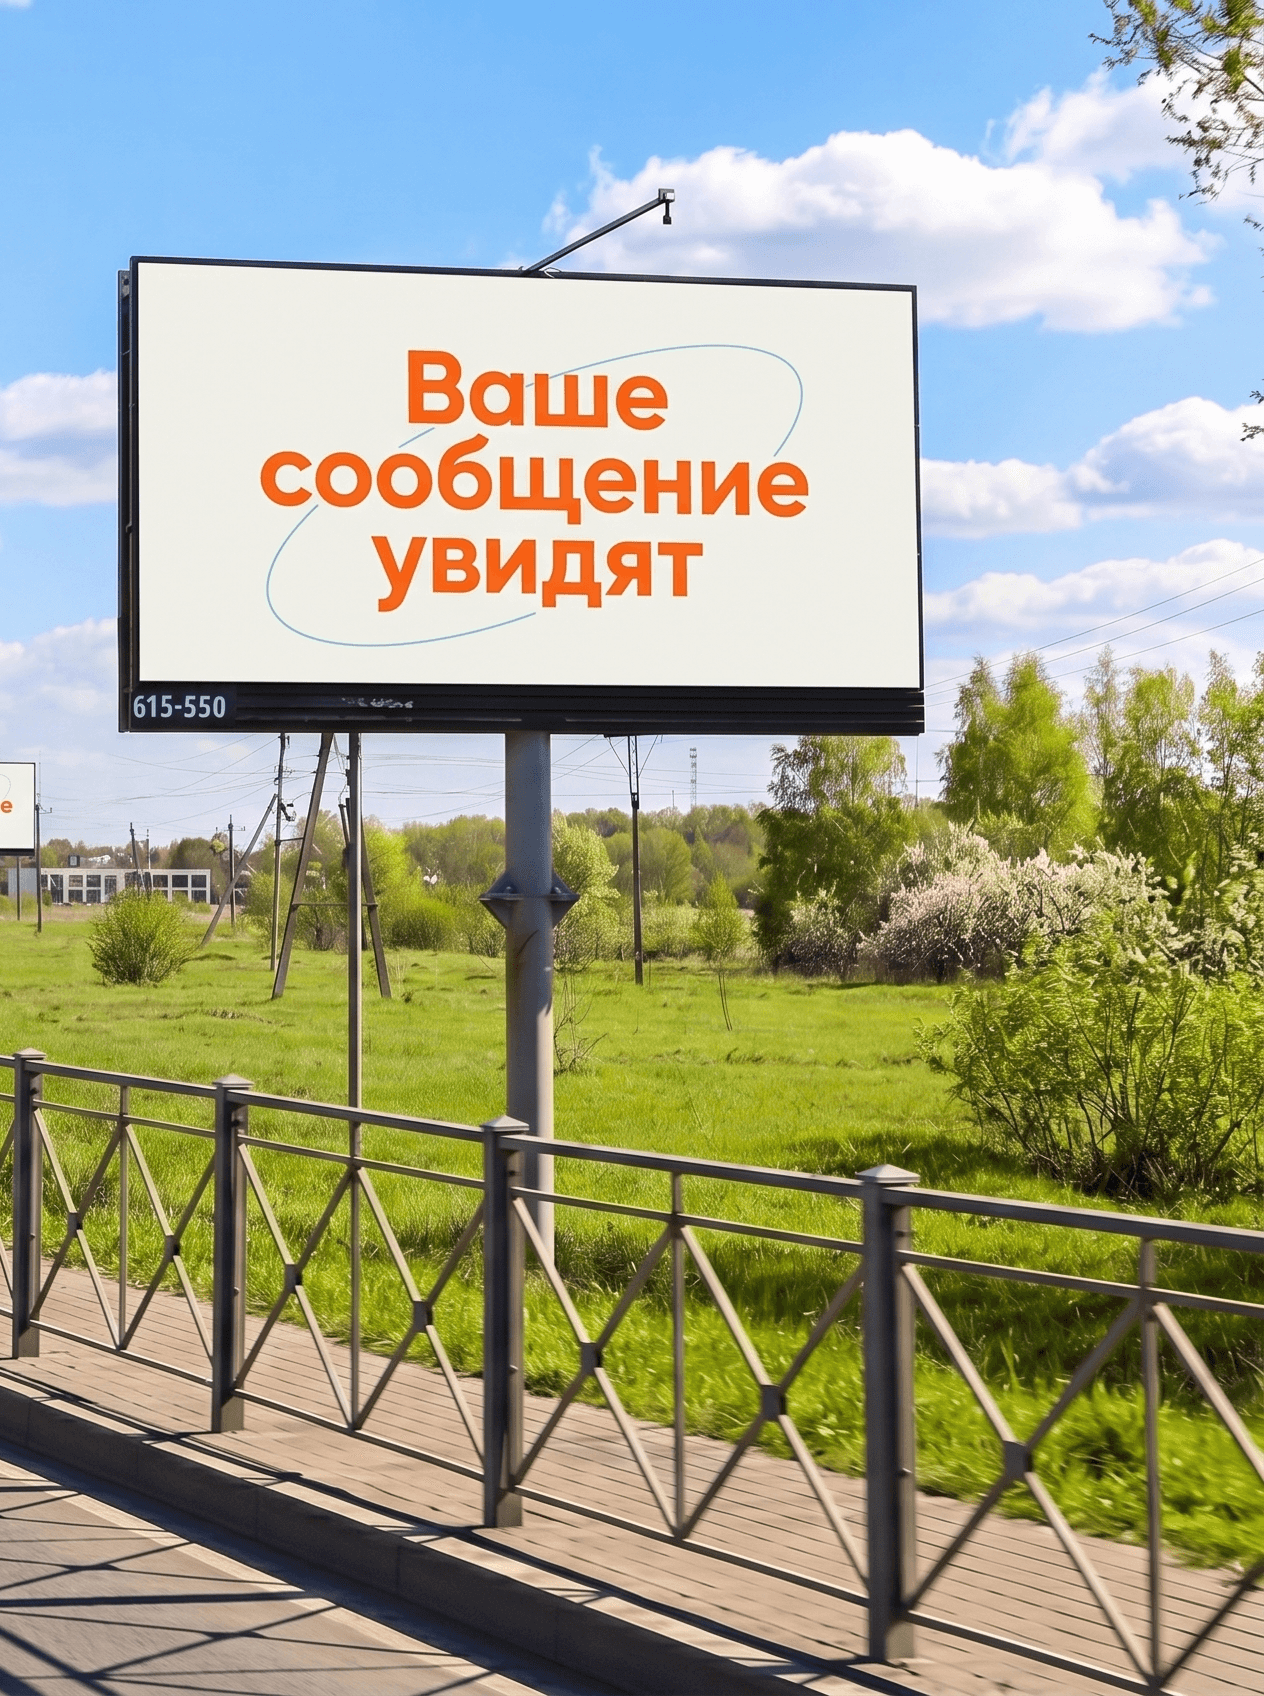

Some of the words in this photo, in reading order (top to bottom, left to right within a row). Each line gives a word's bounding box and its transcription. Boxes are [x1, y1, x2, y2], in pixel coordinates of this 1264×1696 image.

[407, 349, 669, 431] Ваше
[259, 433, 809, 526] сообщение
[371, 535, 704, 613] увидят
[133, 694, 226, 719] 615-550
